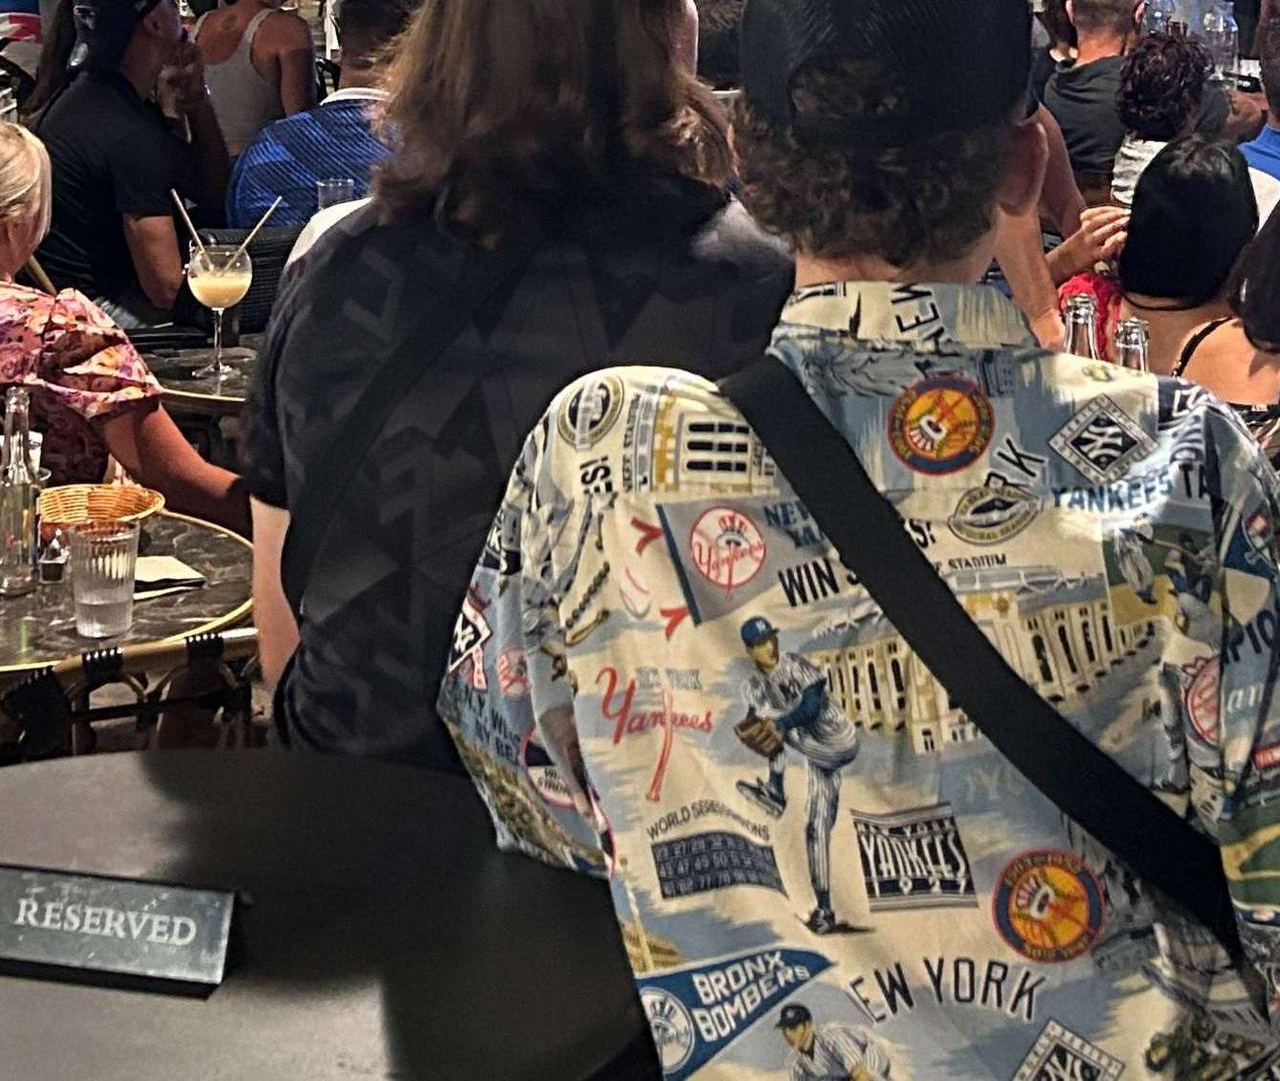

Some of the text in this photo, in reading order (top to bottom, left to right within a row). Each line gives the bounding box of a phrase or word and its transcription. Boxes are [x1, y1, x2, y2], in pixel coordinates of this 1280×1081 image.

[778, 557, 840, 608] WIN
[595, 667, 713, 802] Yankees
[646, 805, 691, 840] WORLD
[14, 897, 197, 946] RESERVED
[692, 951, 784, 1005] BRONX
[692, 964, 810, 1043] BOMBERS
[923, 956, 1045, 1019] YORK
